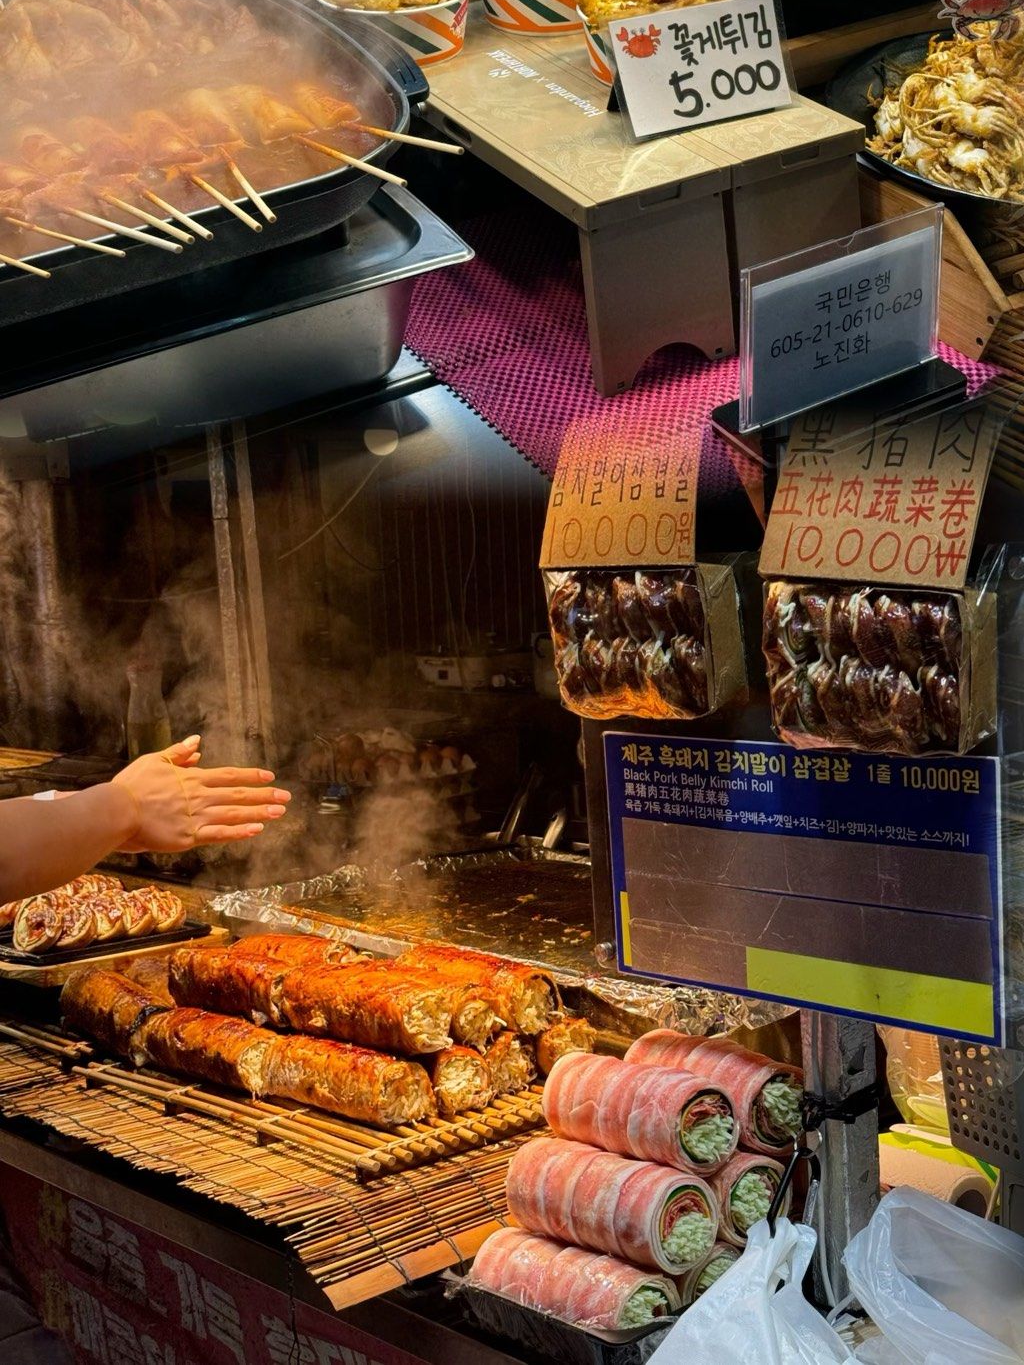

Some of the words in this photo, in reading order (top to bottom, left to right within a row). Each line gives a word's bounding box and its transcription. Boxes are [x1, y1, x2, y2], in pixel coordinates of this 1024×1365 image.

[667, 4, 772, 66] 꽃게튀김
[815, 269, 891, 314] 국민은행
[770, 288, 923, 359] 605-21-0610-629
[813, 331, 871, 370] 노진화
[771, 470, 976, 539] 五花肉蔬菜卷
[622, 743, 654, 765] 제주
[659, 745, 709, 771] 흑돼지
[714, 749, 786, 777] 김치말이
[792, 755, 852, 783] 삼겹살
[867, 763, 891, 784] 1줄
[901, 766, 980, 794] 10,000원
[624, 768, 651, 782] Black
[653, 772, 678, 784] Pork
[681, 775, 707, 790] Belly
[710, 776, 748, 791] Kimchi
[751, 779, 773, 793] Roll
[625, 782, 730, 806] 黑猪肉五花肉蔬菜卷
[645, 801, 661, 813] 가득
[920, 829, 969, 847] 소스까지!
